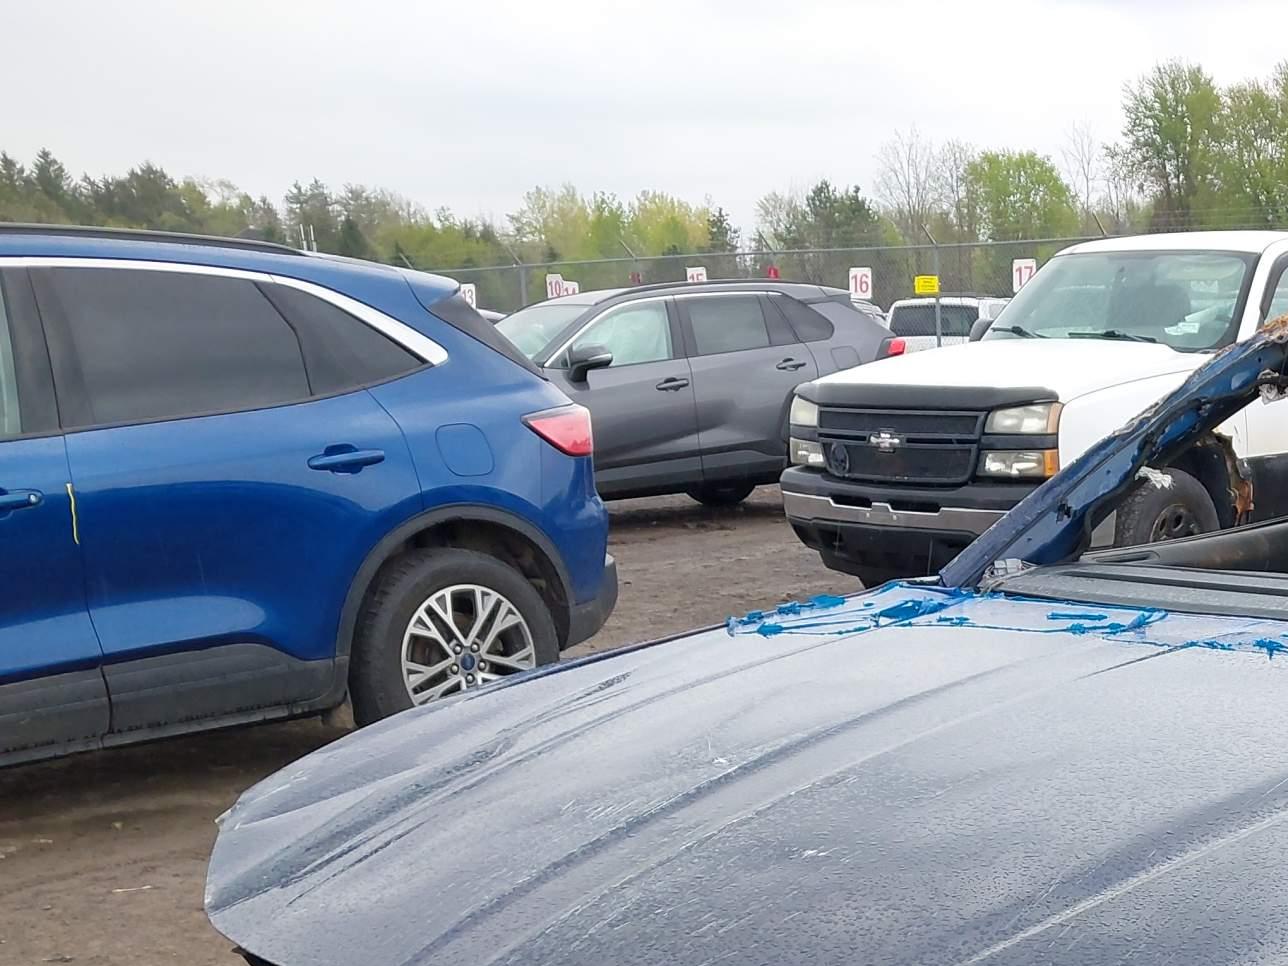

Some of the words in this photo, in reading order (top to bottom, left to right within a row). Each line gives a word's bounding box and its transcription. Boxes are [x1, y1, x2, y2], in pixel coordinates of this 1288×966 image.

[851, 273, 869, 293] 16
[1015, 265, 1033, 287] 17
[462, 288, 474, 305] 13
[548, 280, 561, 297] 10
